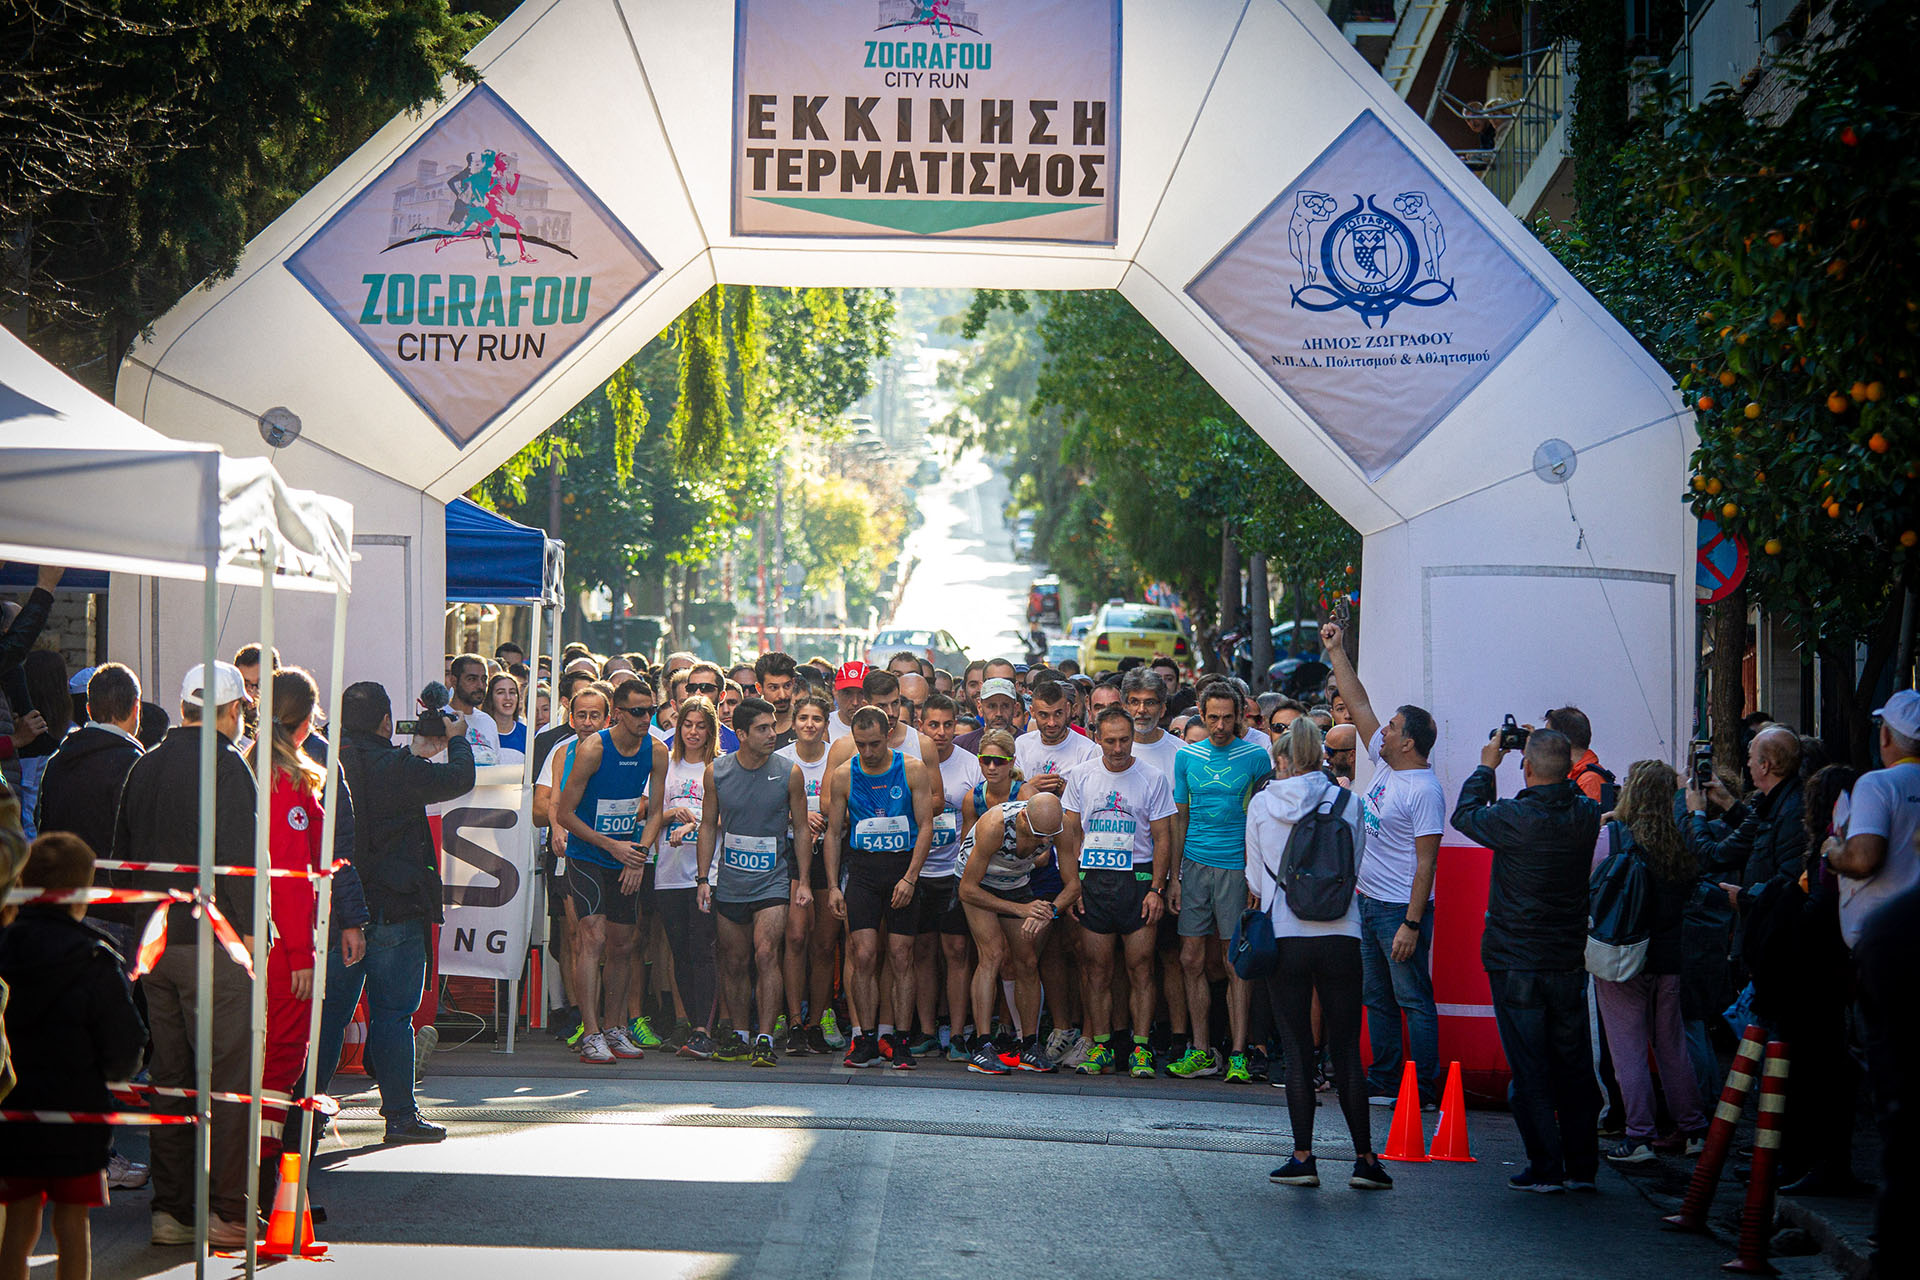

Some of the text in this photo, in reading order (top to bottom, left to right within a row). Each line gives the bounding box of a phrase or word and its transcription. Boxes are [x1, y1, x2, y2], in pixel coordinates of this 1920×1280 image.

[864, 40, 992, 71] ZOGRAFOU
[884, 72, 969, 89] CITY RUN
[747, 94, 1106, 146] ΕΚΚΙΝΗΣΗ
[746, 148, 1105, 198] ΤΕΡΜΑΤΙΣΜΟΣ
[359, 273, 592, 327] ZOGRAFOU
[397, 332, 546, 362] CITY RUN
[1301, 332, 1454, 351] ΔΗΜΟΣ ΖΩΓΡΑΦΟΥ
[1271, 349, 1490, 369] Ν.Π.Δ.Δ. Πολιτισμού & Αθλητισμού
[1089, 819, 1137, 834] ZOGRAFOU
[863, 834, 904, 850] 5430
[932, 832, 950, 845] 47
[730, 851, 770, 869] 5005
[1087, 851, 1127, 867] 5350
